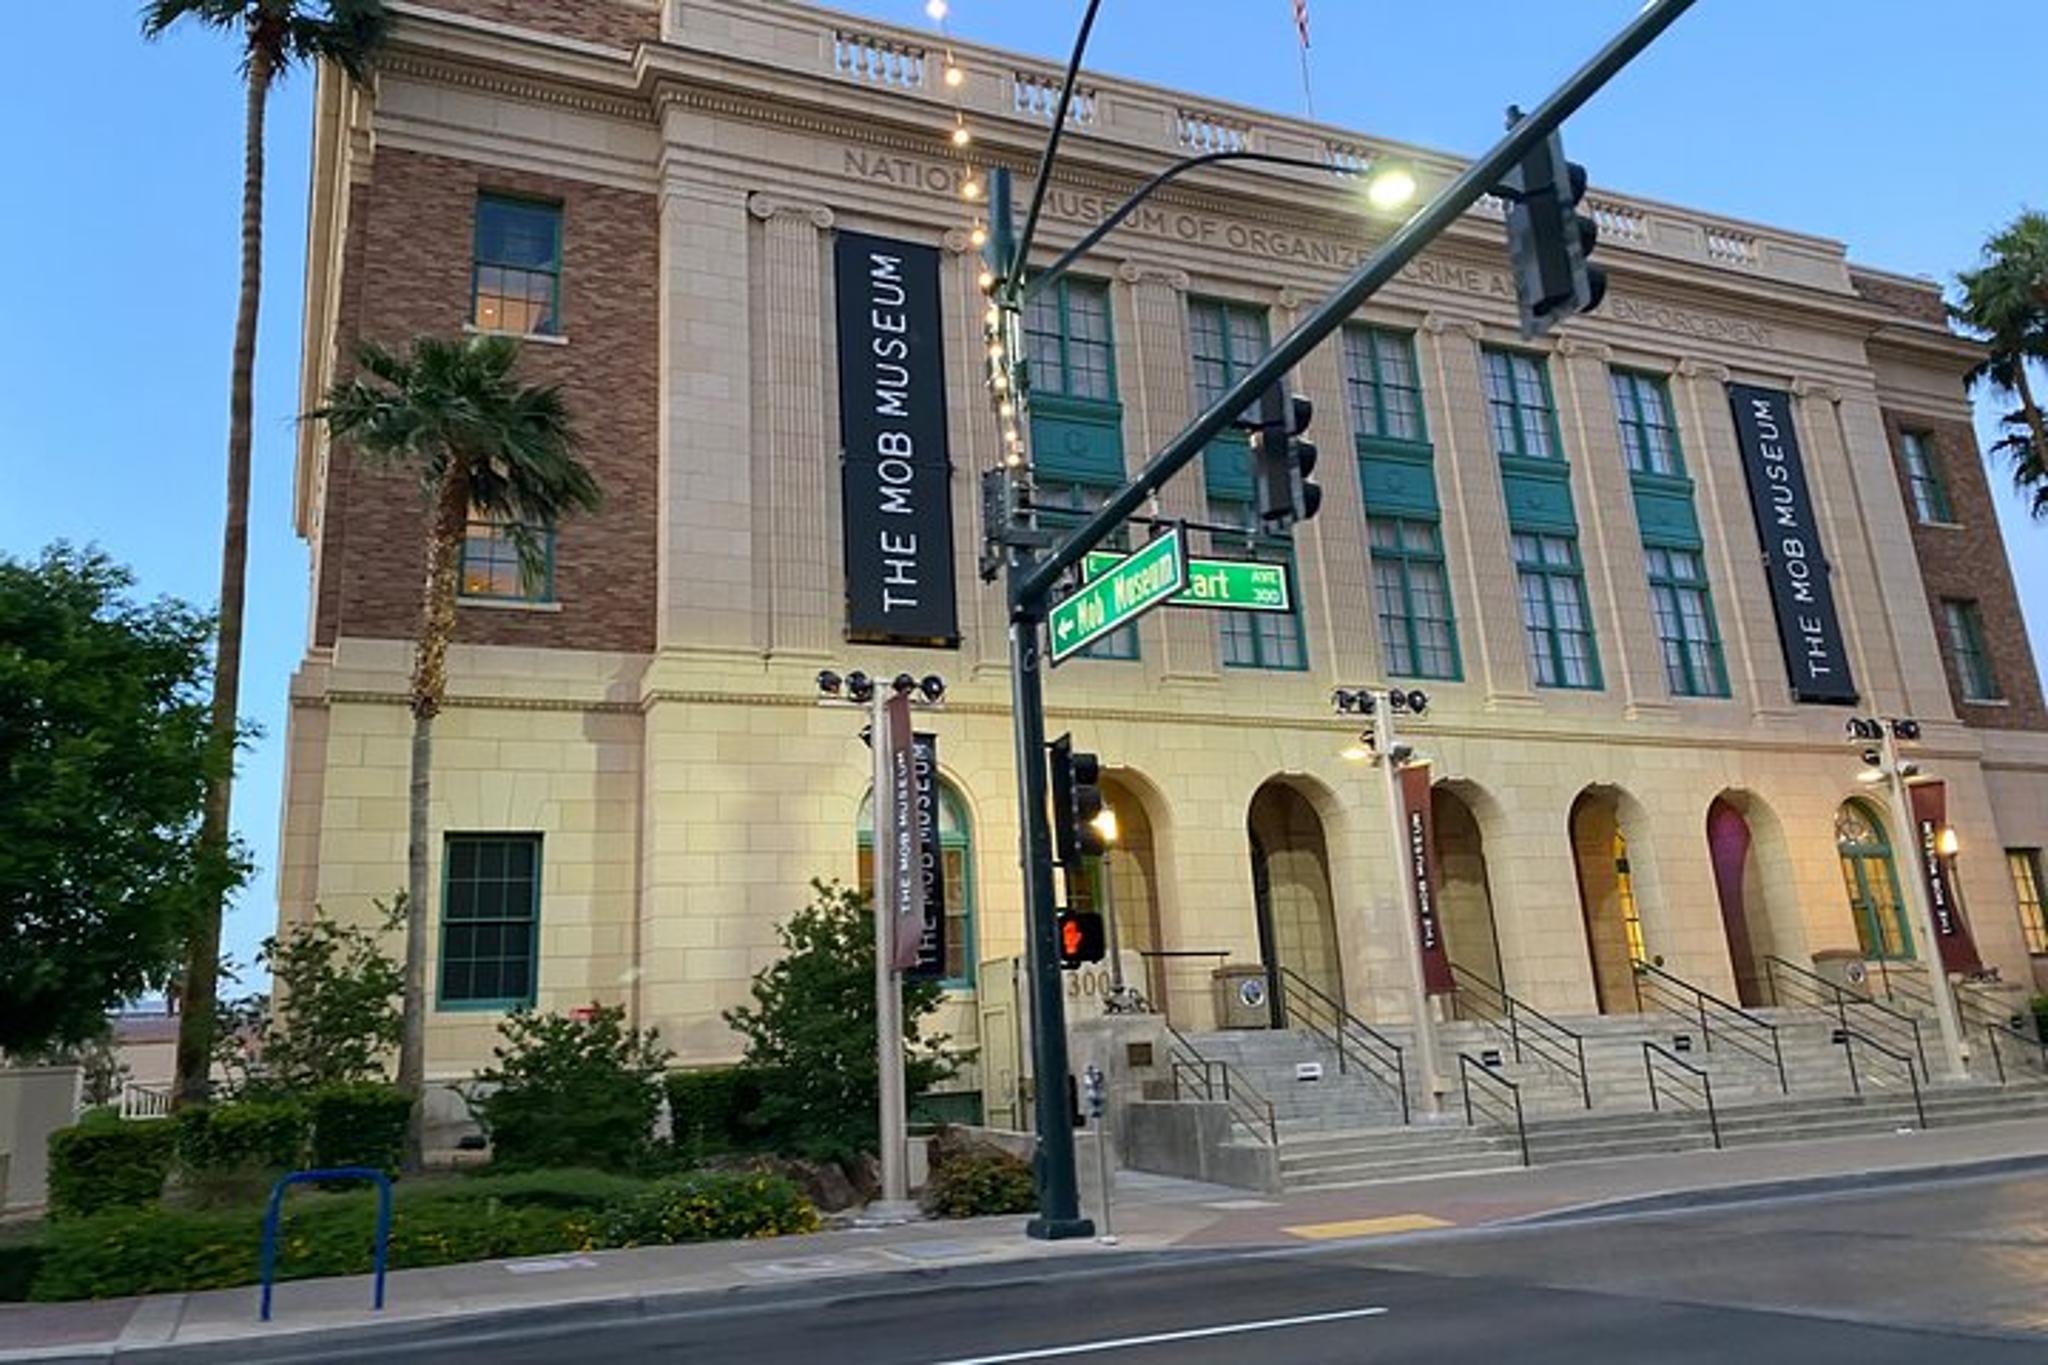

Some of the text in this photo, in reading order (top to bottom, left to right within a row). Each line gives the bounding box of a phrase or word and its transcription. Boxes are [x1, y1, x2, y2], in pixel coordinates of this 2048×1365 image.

[1176, 214, 1216, 241] OF
[1227, 225, 1369, 271] ORGANIZE
[1402, 260, 1482, 291] CRIME
[870, 253, 917, 613] THE MOB MUSEUM
[1078, 553, 1174, 637] Mob Museum
[1751, 399, 1831, 678] THE MOB MUSEUM
[896, 751, 911, 913] THE MOB MUSEUM
[1067, 971, 1110, 997] 300
